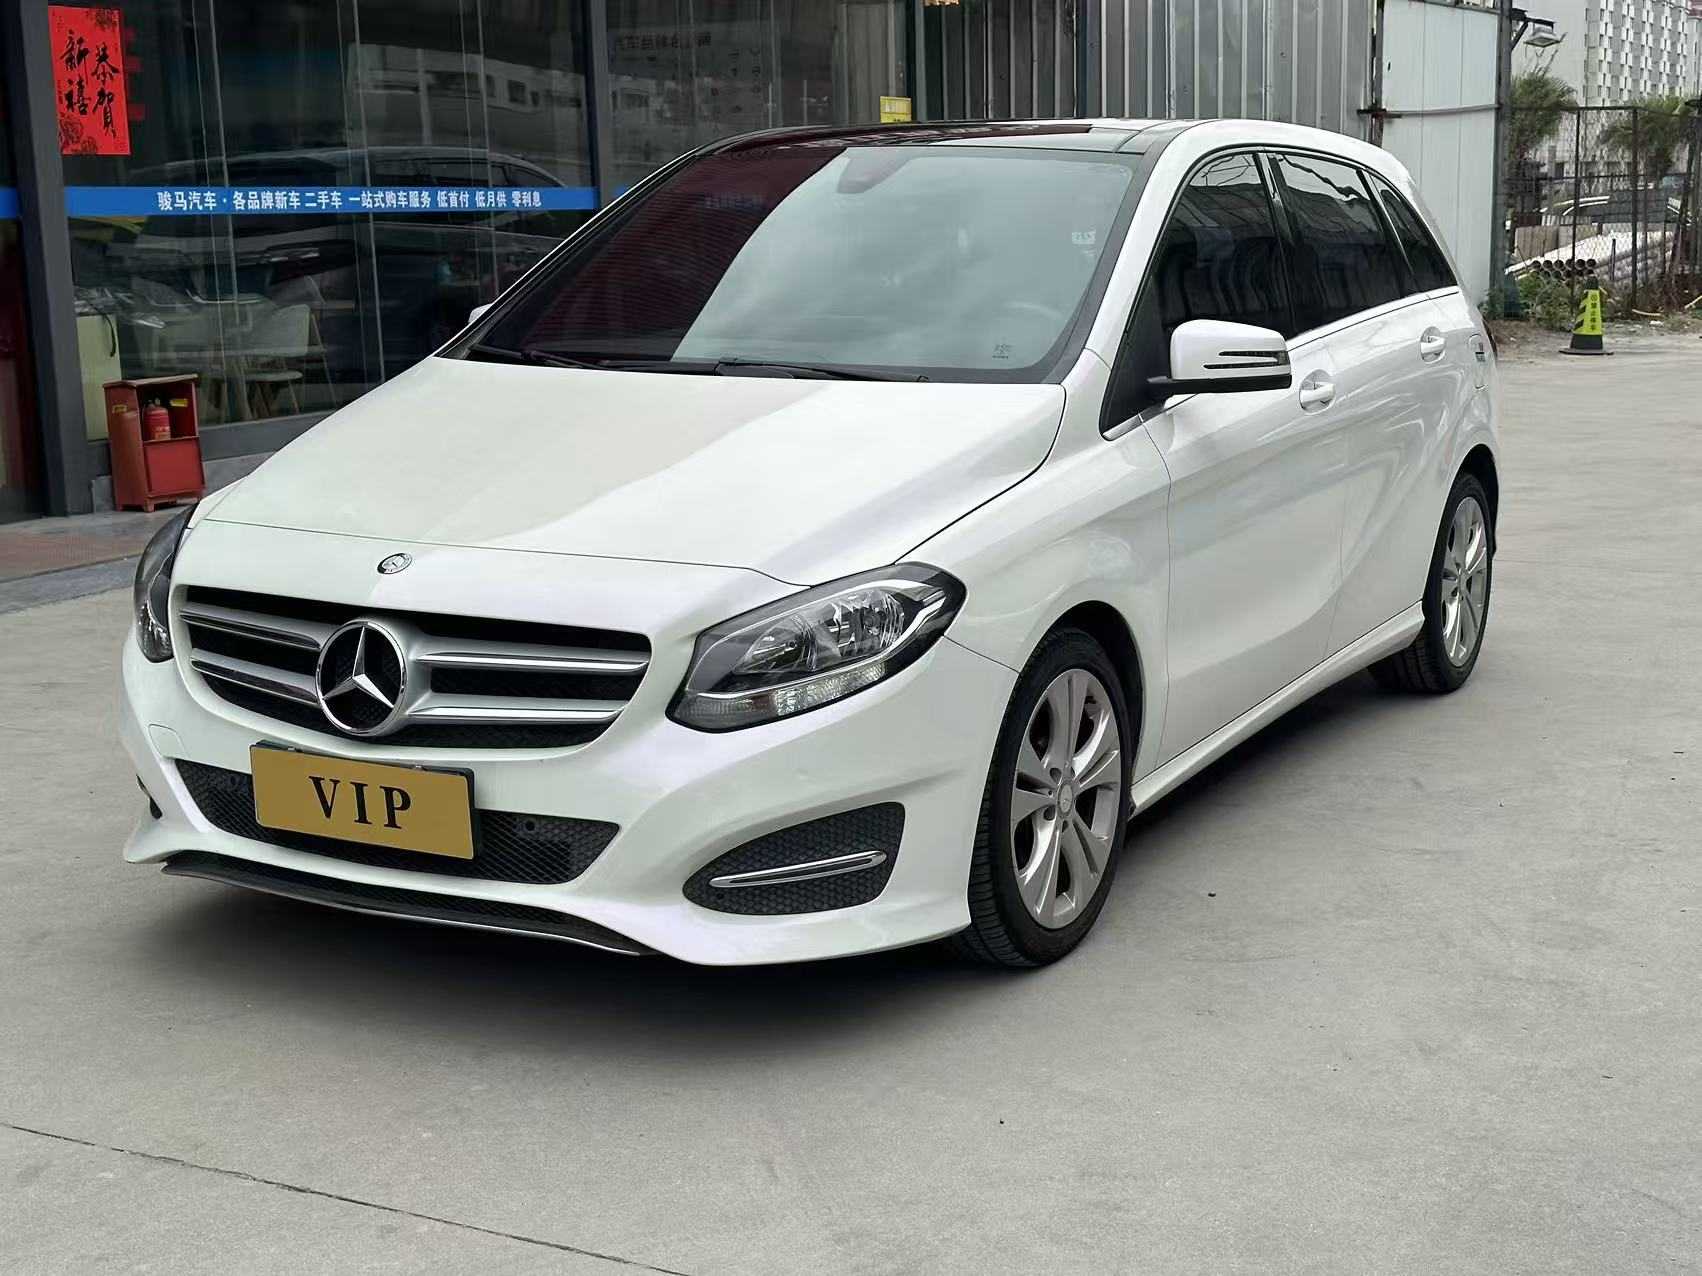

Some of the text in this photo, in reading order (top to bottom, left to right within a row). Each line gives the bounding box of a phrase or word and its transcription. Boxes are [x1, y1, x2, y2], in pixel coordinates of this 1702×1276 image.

[304, 191, 342, 210] 二手车
[349, 190, 431, 209] 一站式购车服务
[436, 190, 469, 208] 低首付
[475, 190, 507, 208] 低月供
[511, 190, 542, 208] 零利息
[308, 776, 411, 829] VIP
